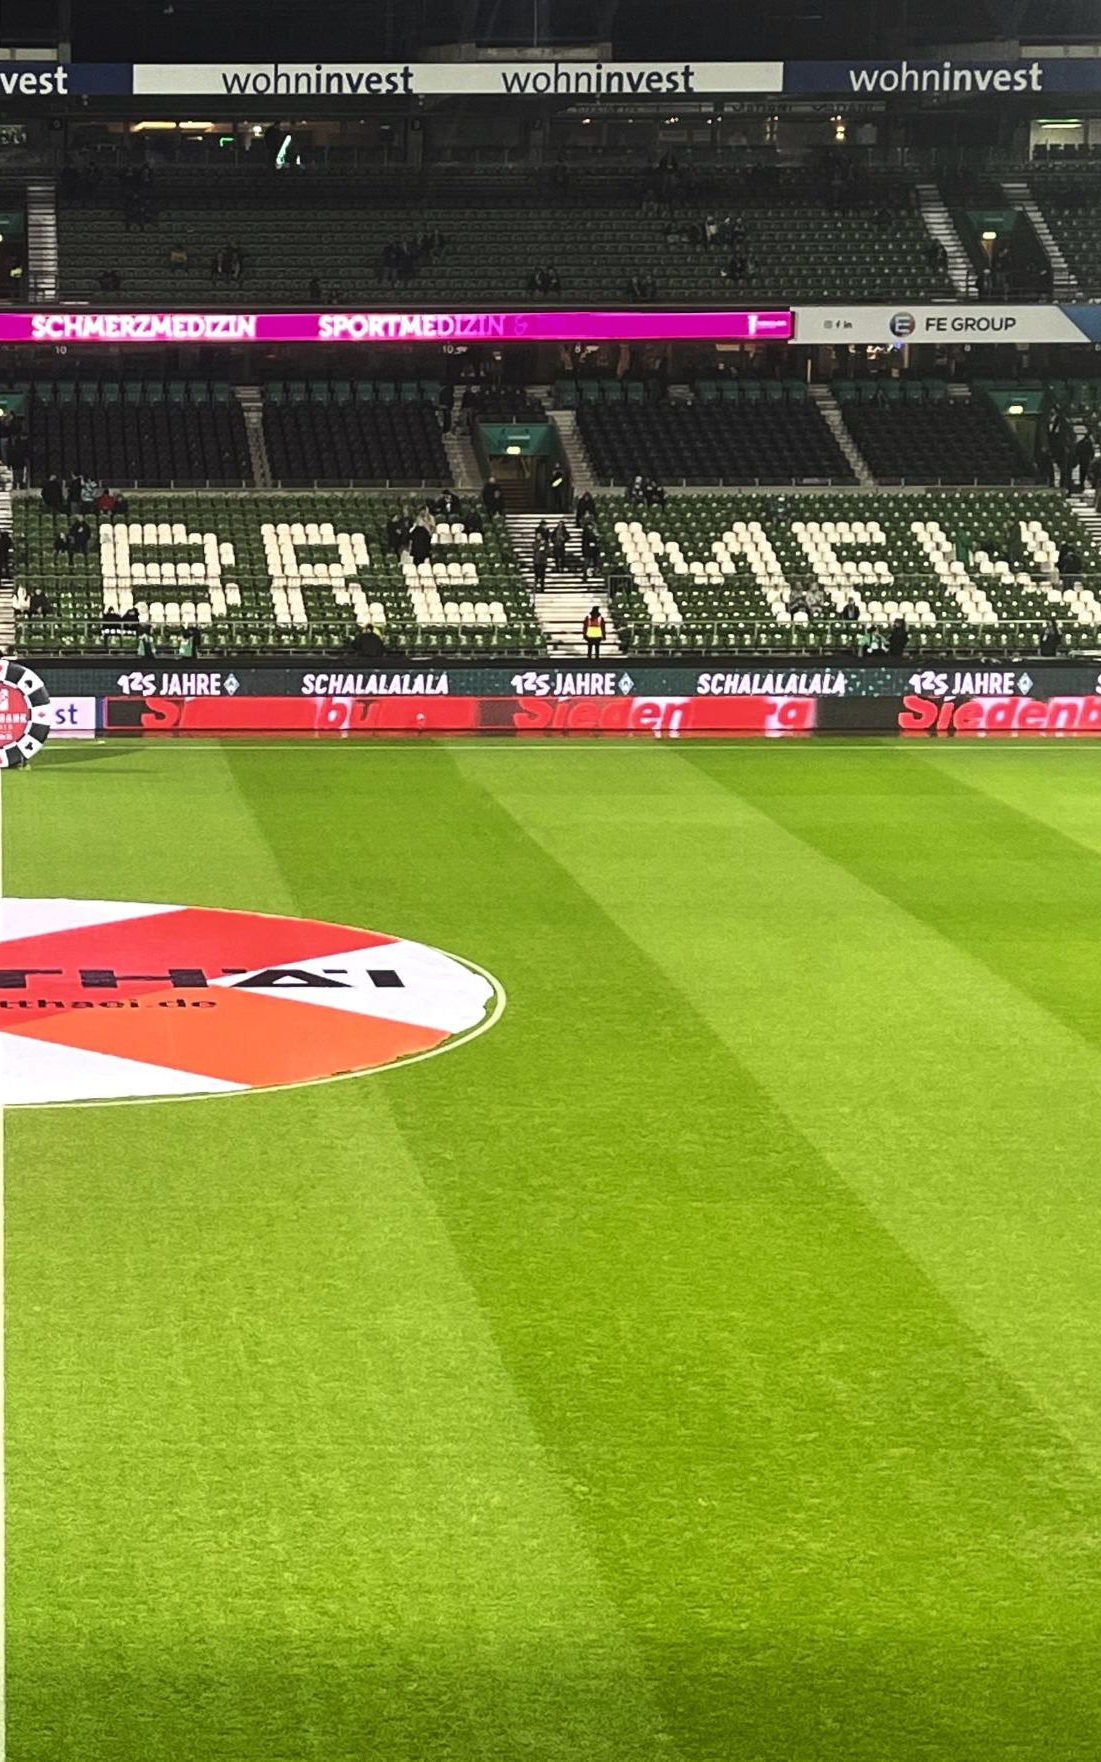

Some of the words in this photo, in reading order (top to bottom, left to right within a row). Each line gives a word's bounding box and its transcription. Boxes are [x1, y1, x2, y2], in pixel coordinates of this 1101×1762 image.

[222, 64, 414, 95] wohninvest
[502, 63, 695, 93] wohninvest
[849, 61, 1043, 92] wohninvest
[31, 315, 256, 338] SCHMERZMEDIZIN
[318, 315, 506, 338] SPORTMEDIZIN
[925, 318, 948, 332] FE
[951, 317, 1017, 332] GROUP
[159, 673, 221, 695] JAHRE
[553, 673, 616, 695] JAHRE
[952, 672, 1015, 694] JAHRE
